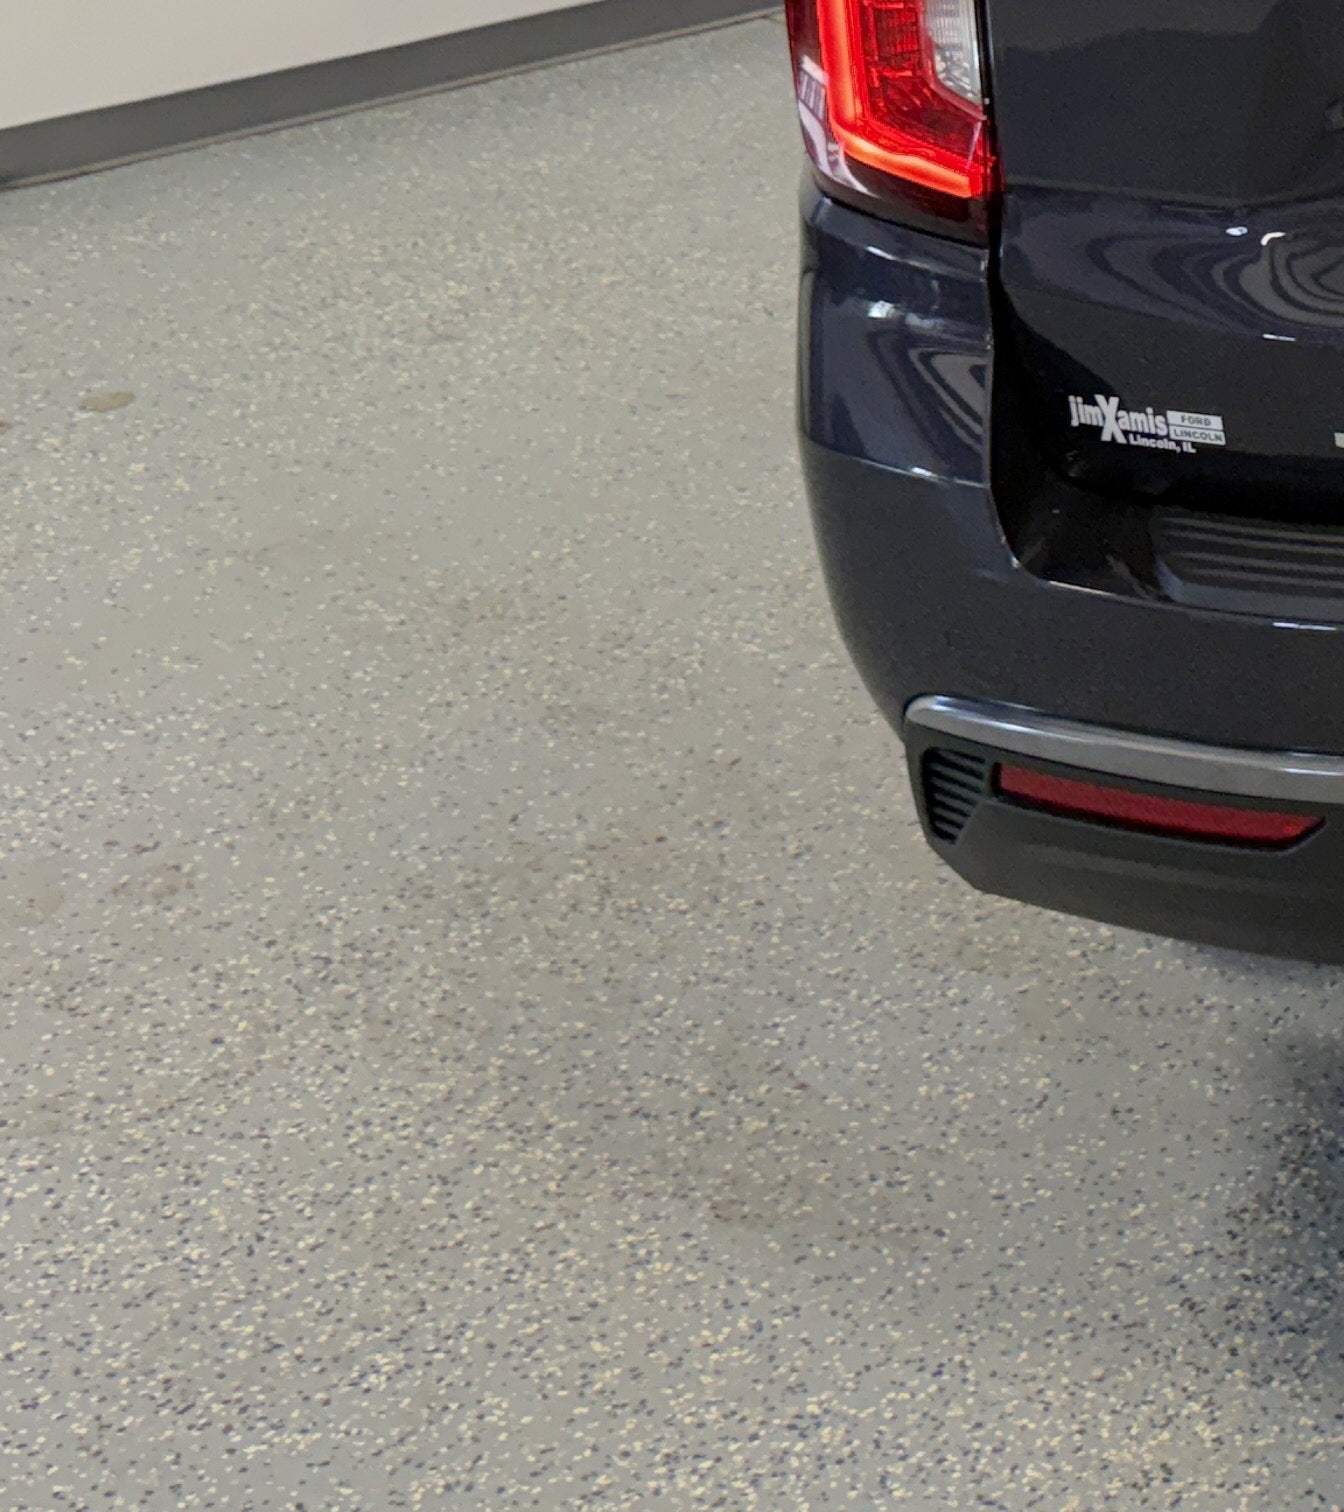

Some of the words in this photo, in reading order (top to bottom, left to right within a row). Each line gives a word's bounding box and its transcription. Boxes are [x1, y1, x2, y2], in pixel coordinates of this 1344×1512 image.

[1180, 415, 1212, 426] FORD
[1173, 429, 1224, 442] LINCOLN
[1128, 433, 1181, 453] Lincoln,
